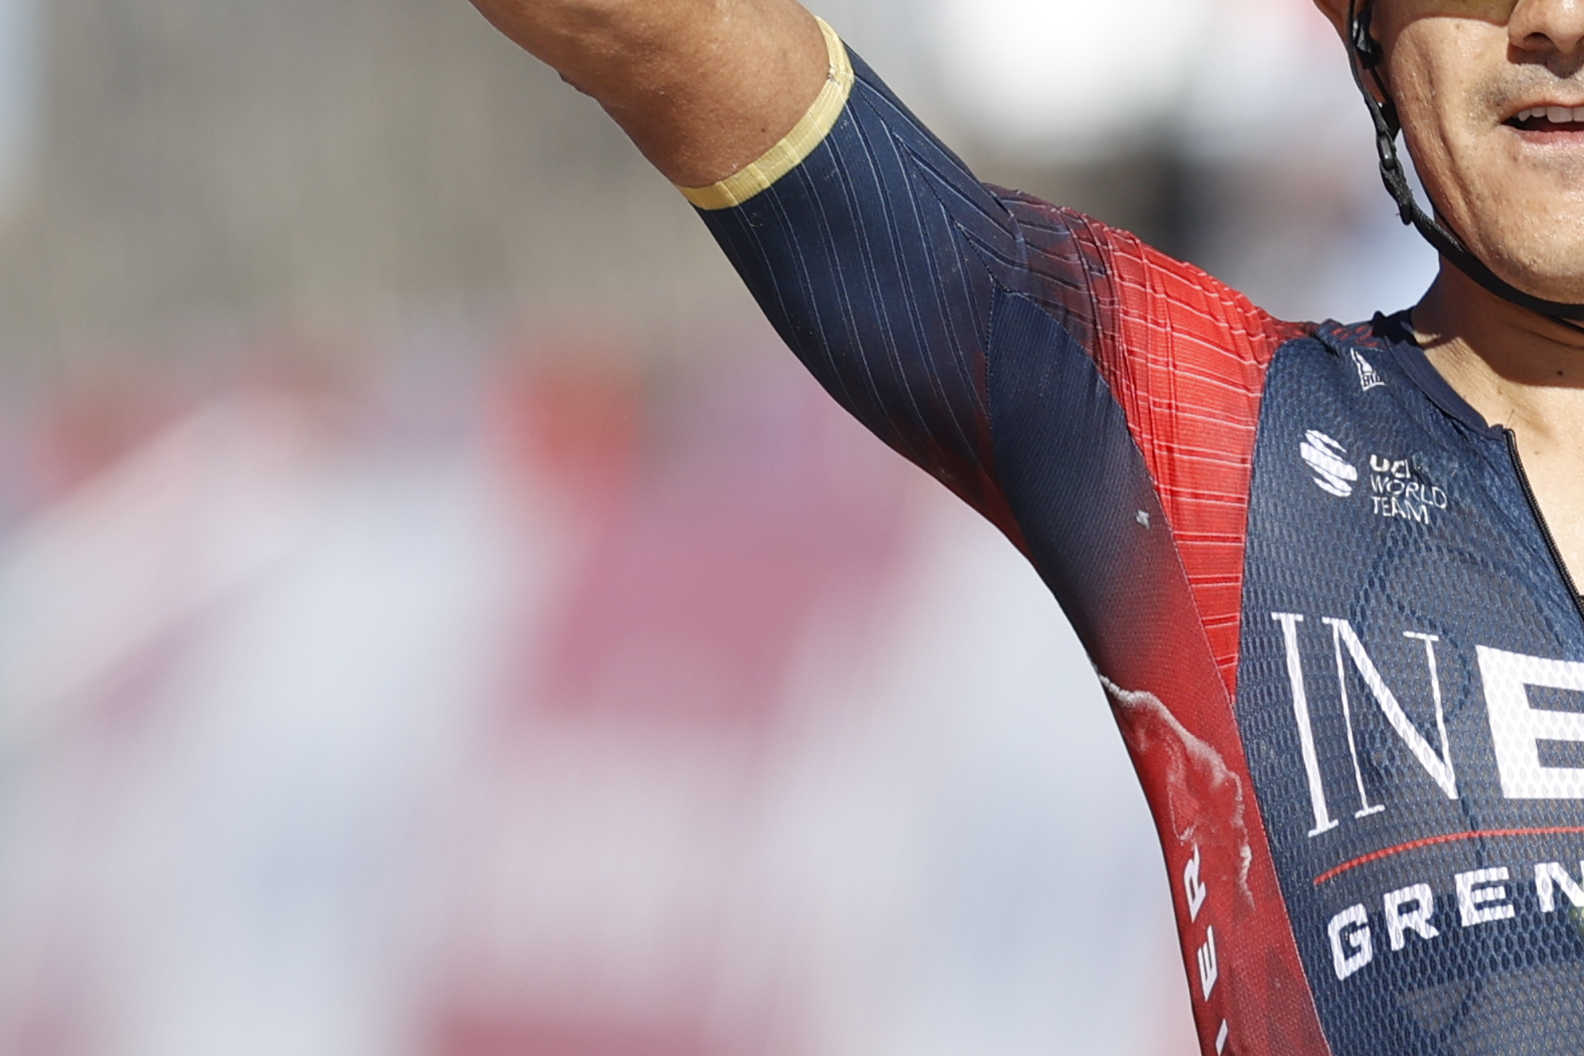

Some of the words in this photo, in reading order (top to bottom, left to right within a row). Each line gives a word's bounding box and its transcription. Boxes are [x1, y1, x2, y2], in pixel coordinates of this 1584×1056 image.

[1369, 454, 1411, 479] UCI
[1370, 474, 1448, 509] WORLD
[1371, 496, 1429, 525] TEAM
